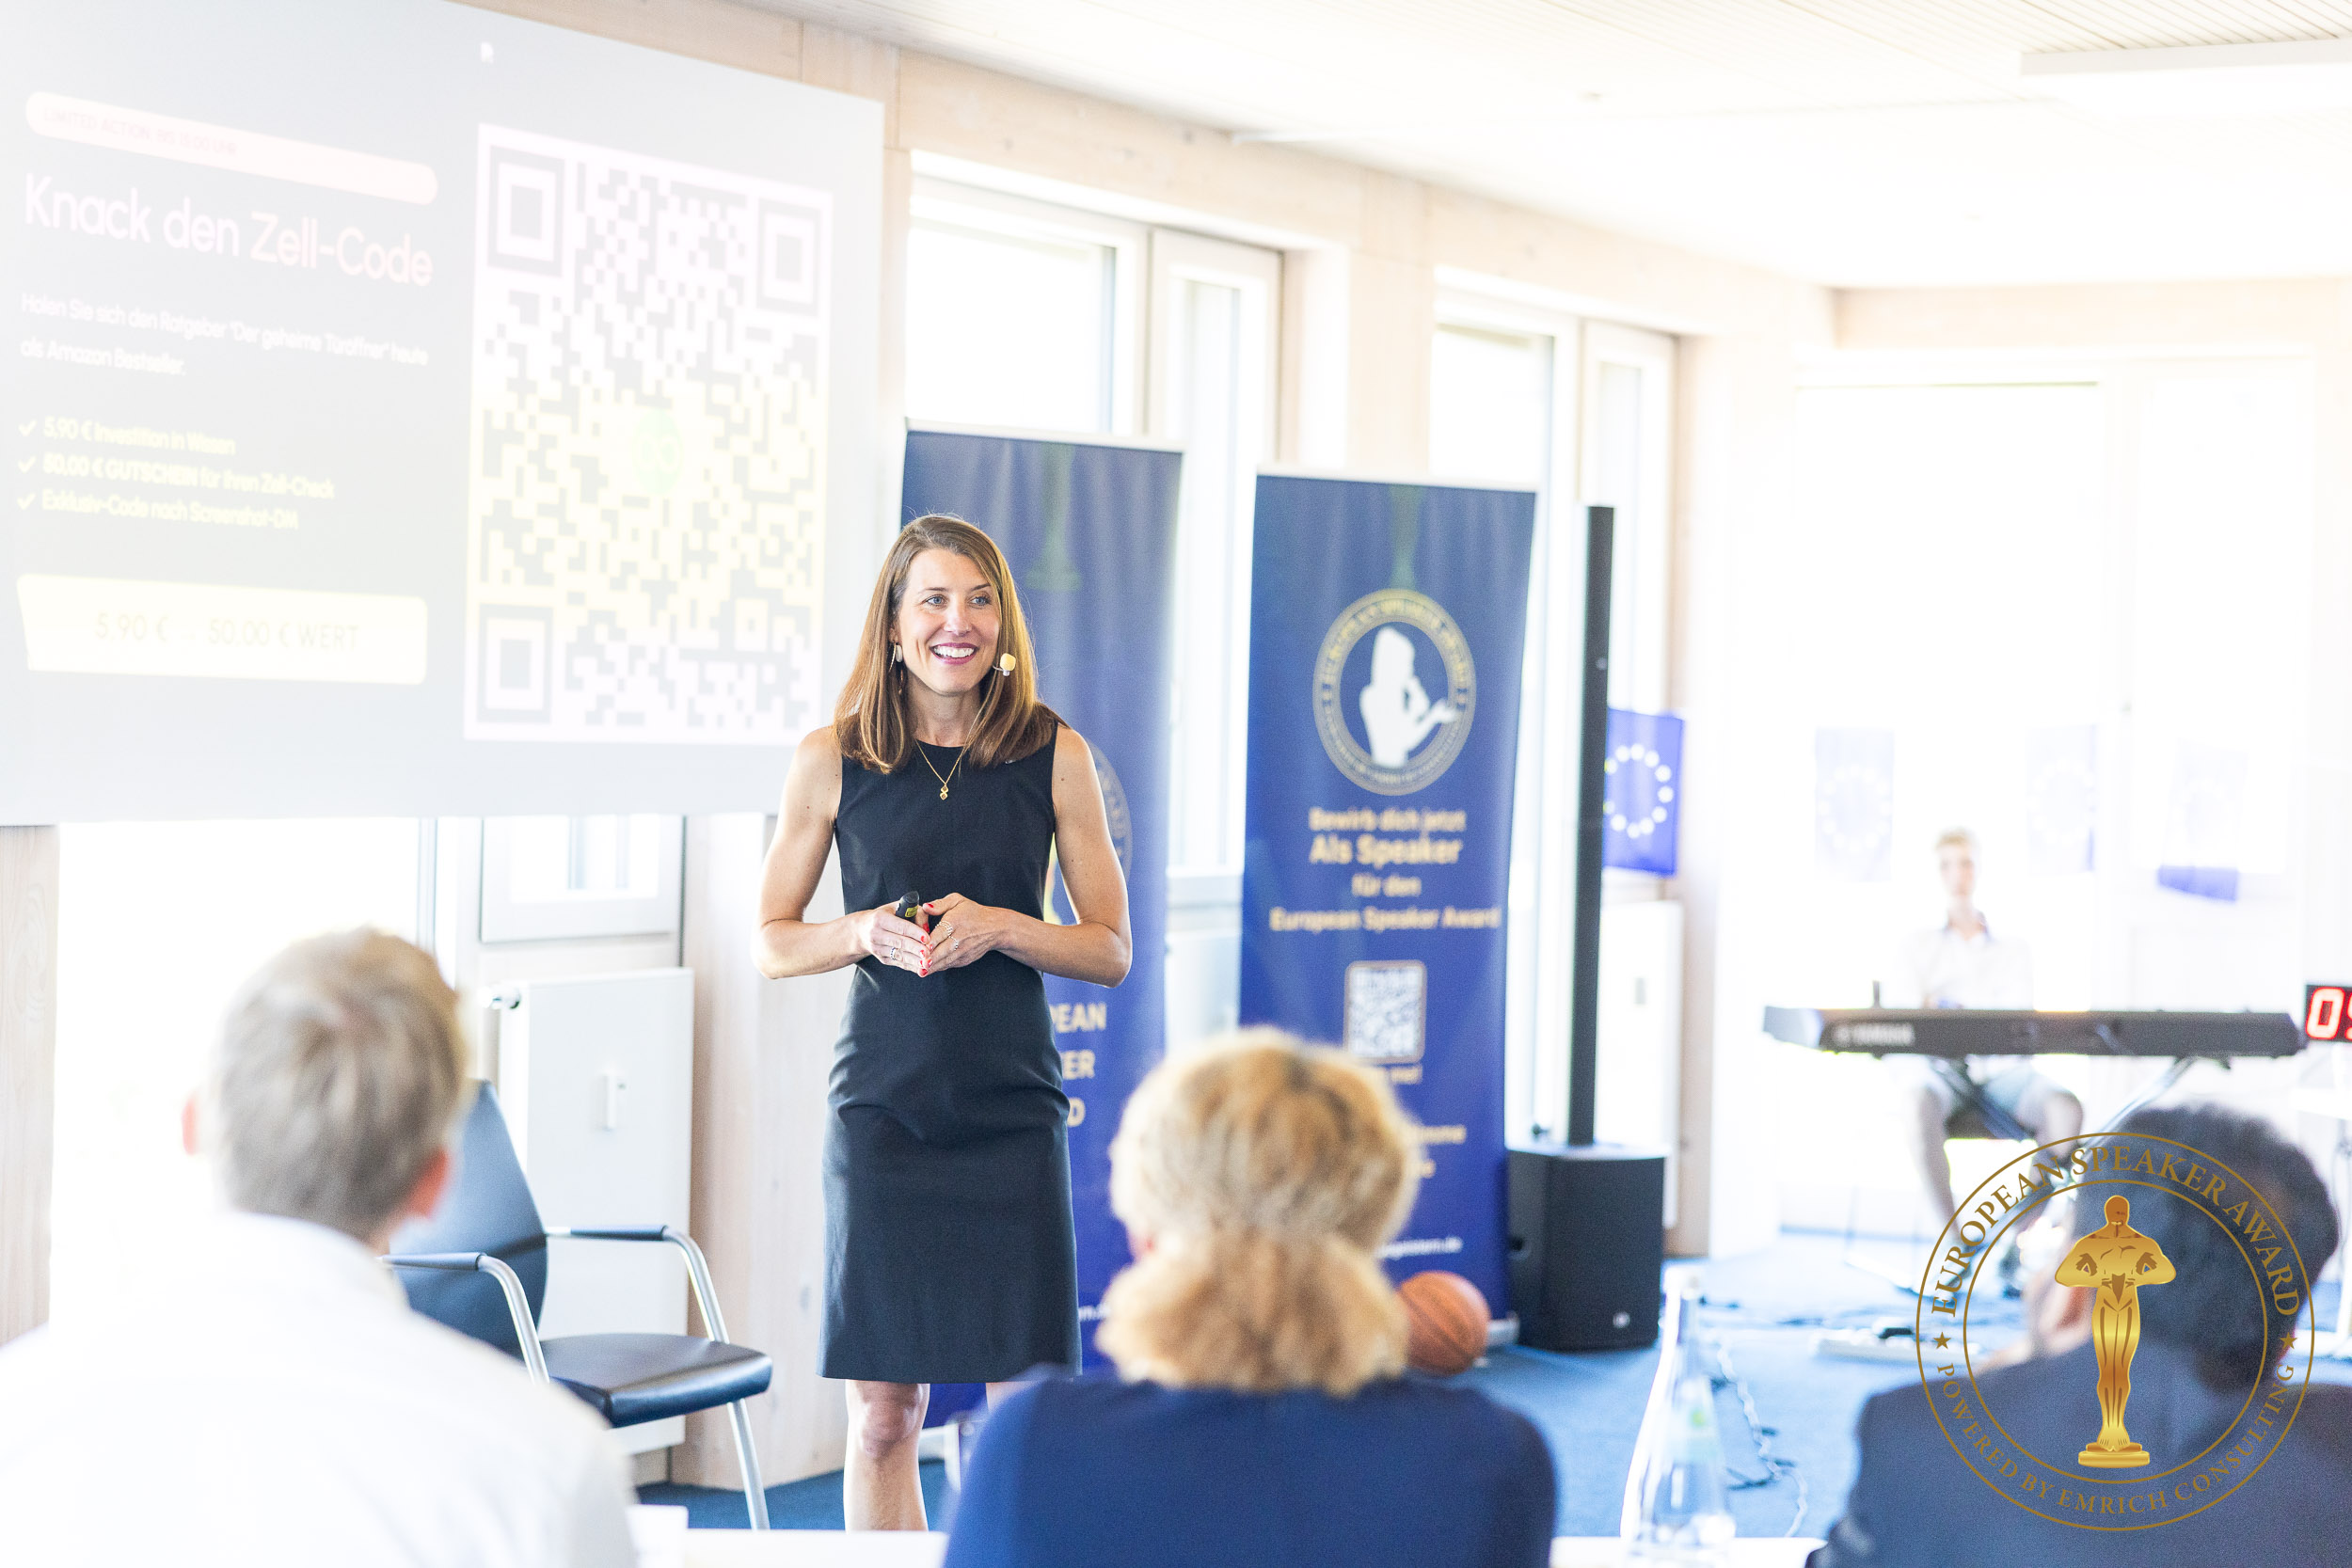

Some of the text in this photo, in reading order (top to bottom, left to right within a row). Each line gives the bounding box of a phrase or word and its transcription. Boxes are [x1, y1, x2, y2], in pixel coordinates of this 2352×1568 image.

[25, 173, 434, 287] Knack den Zell-Code
[22, 292, 66, 317] Holen
[69, 298, 94, 321] Sie
[96, 303, 126, 325] sich
[128, 306, 158, 329] den
[159, 309, 228, 340] Ratgeber
[21, 336, 44, 357] als
[47, 340, 112, 367] Amazon
[295, 622, 360, 651] WERT
[1309, 833, 1463, 869] Als Speaker
[1269, 906, 1502, 934] European Speaker Award
